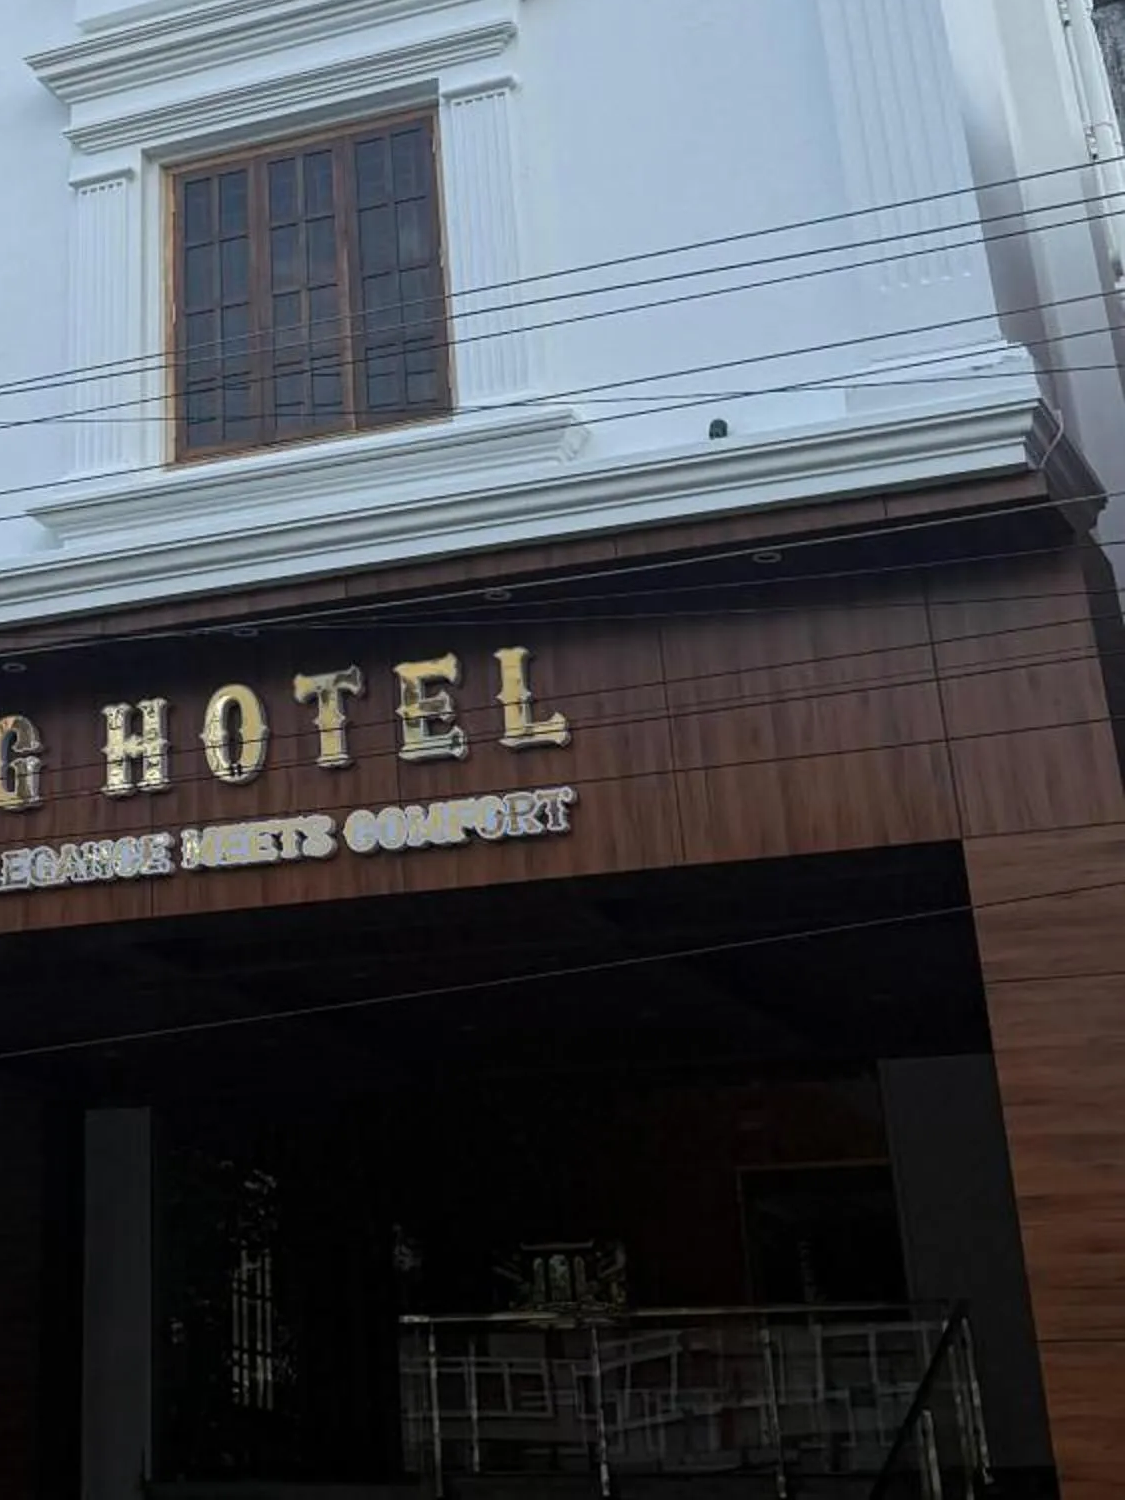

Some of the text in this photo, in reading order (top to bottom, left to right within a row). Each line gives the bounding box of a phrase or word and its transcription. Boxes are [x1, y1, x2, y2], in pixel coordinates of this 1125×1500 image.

[101, 646, 571, 798] HOTEL
[181, 814, 338, 870] MEETS
[343, 786, 576, 854] COMFORT
